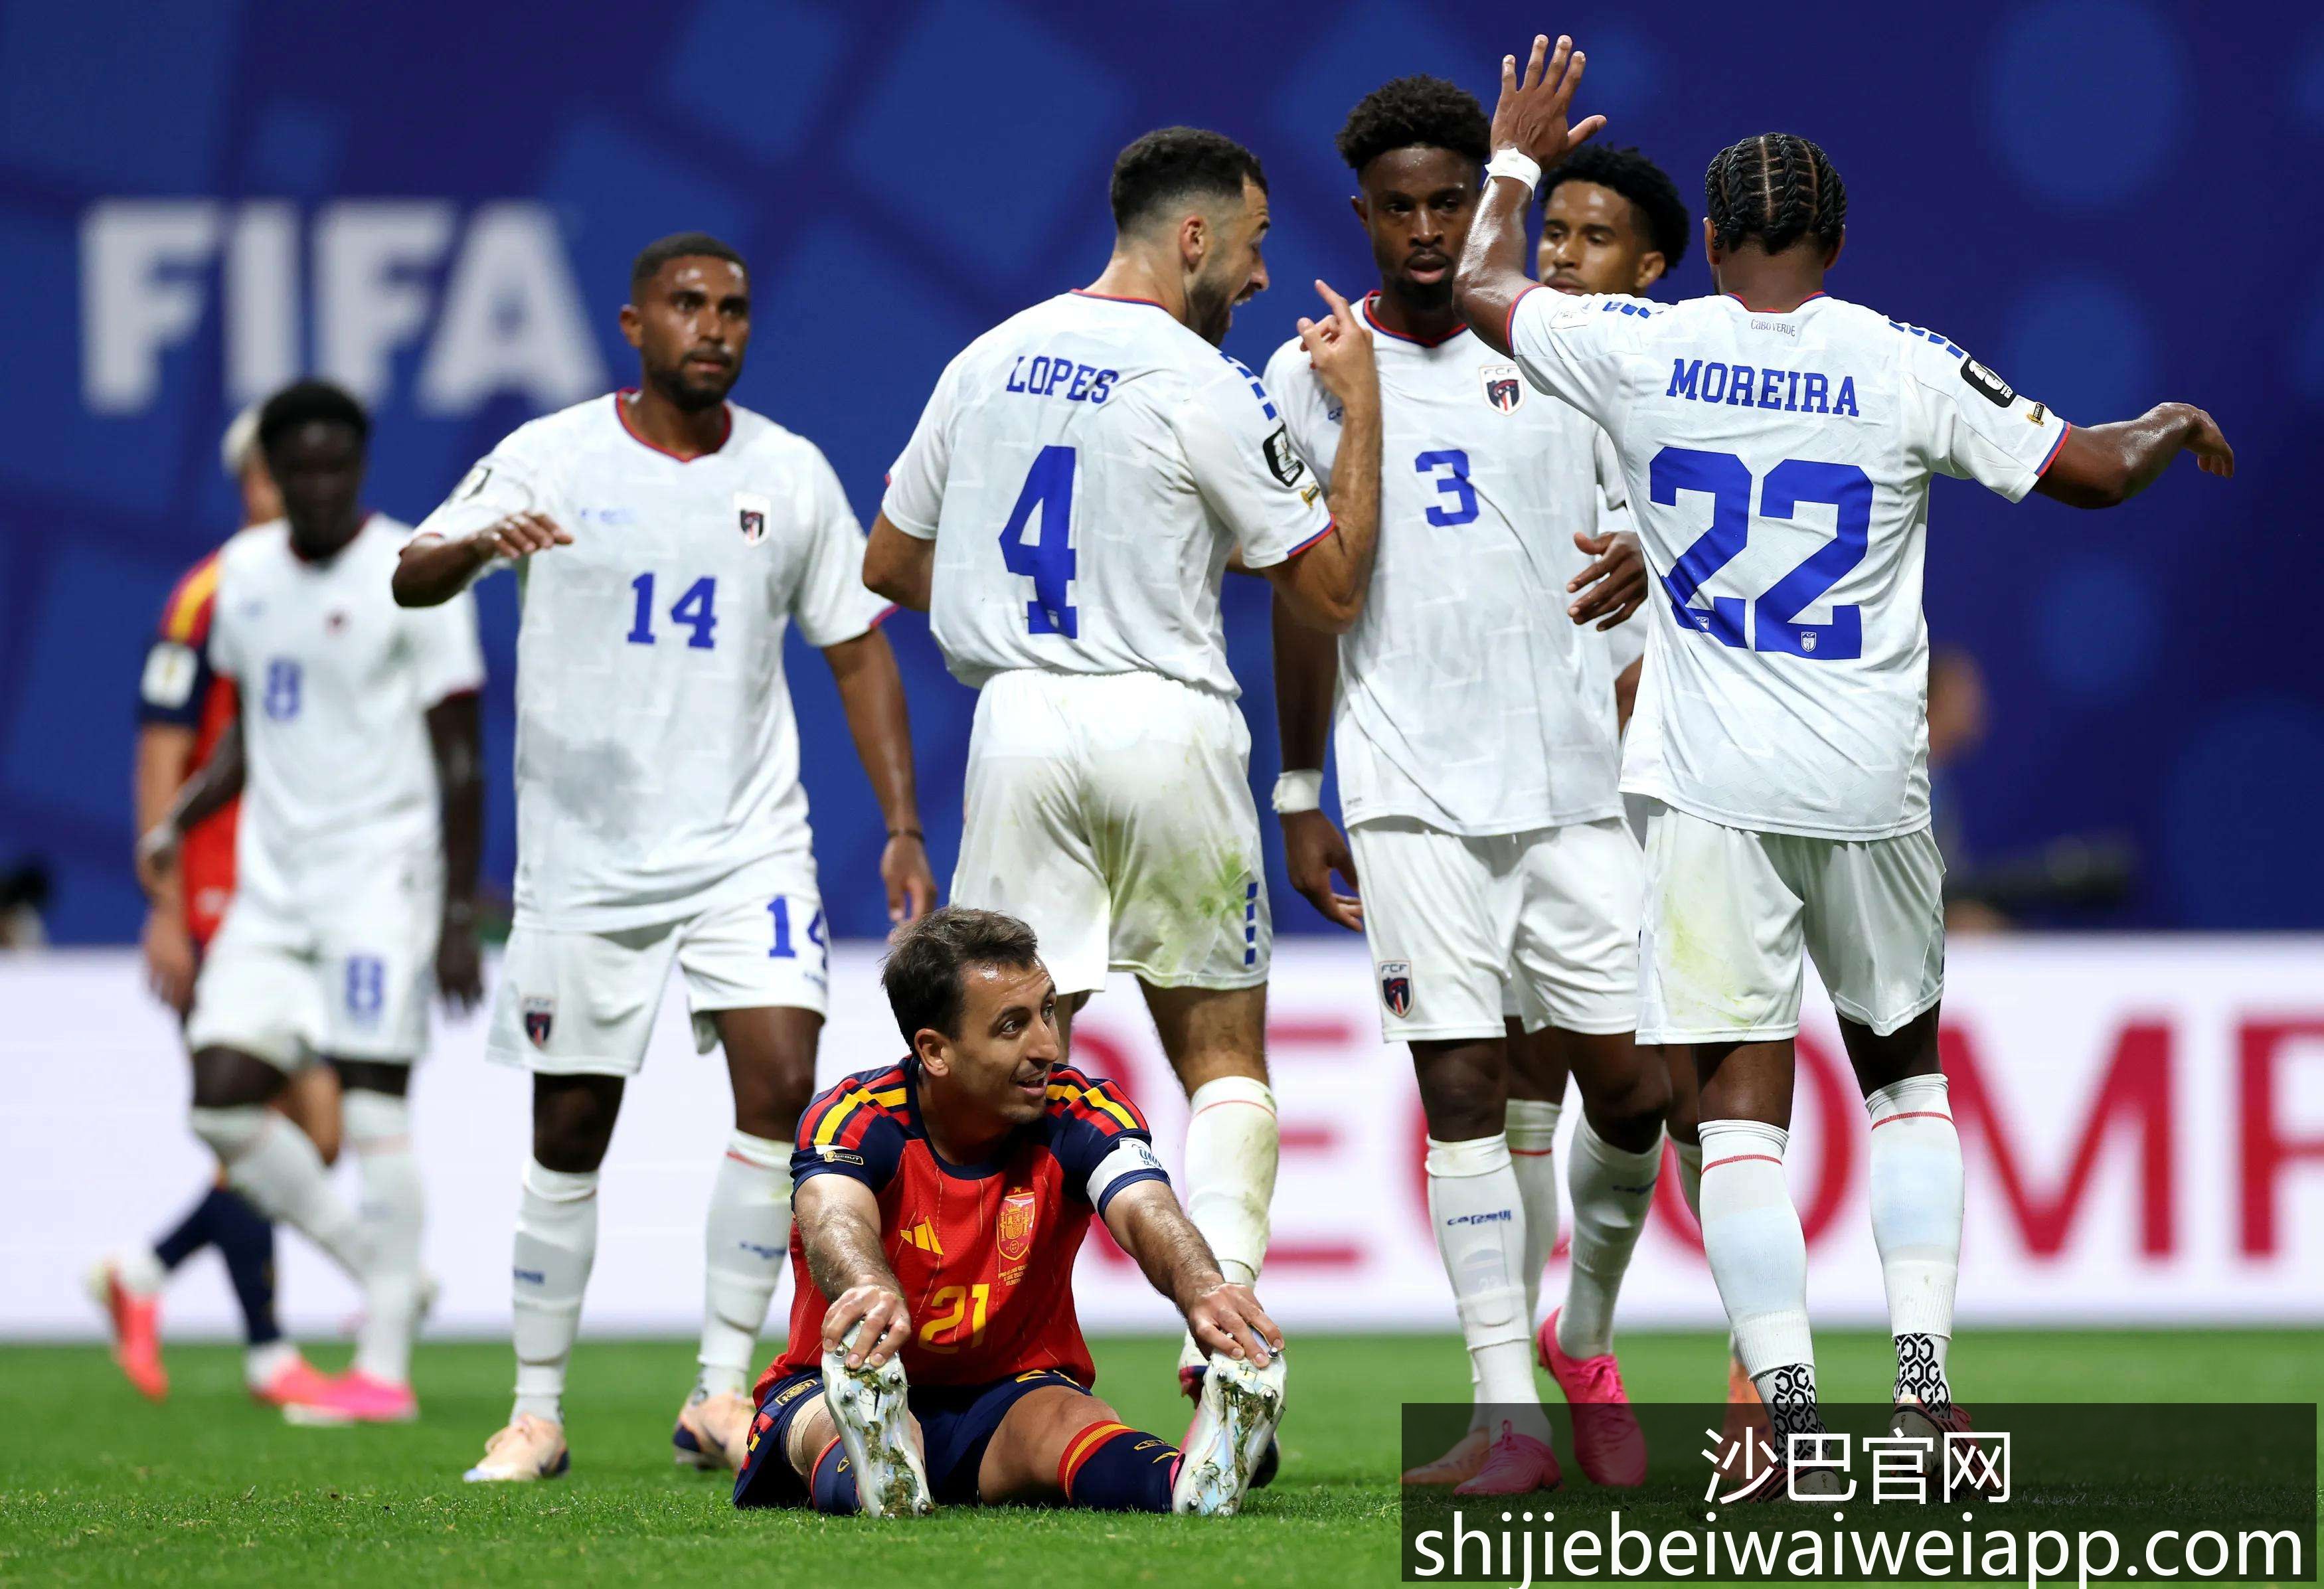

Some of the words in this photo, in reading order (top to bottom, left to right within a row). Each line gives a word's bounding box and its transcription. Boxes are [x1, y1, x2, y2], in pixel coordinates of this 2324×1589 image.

[81, 203, 603, 414] FIFA
[1006, 356, 1118, 404] LOPES
[1667, 359, 1859, 417] MOREIRA
[1415, 450, 1479, 527] 3
[999, 446, 1078, 639] 4
[1649, 446, 1874, 660] 22
[627, 572, 717, 649] 14
[264, 656, 302, 721] 8
[344, 955, 385, 1027] 8
[1381, 963, 1408, 974] FCF
[917, 1283, 991, 1355] 21
